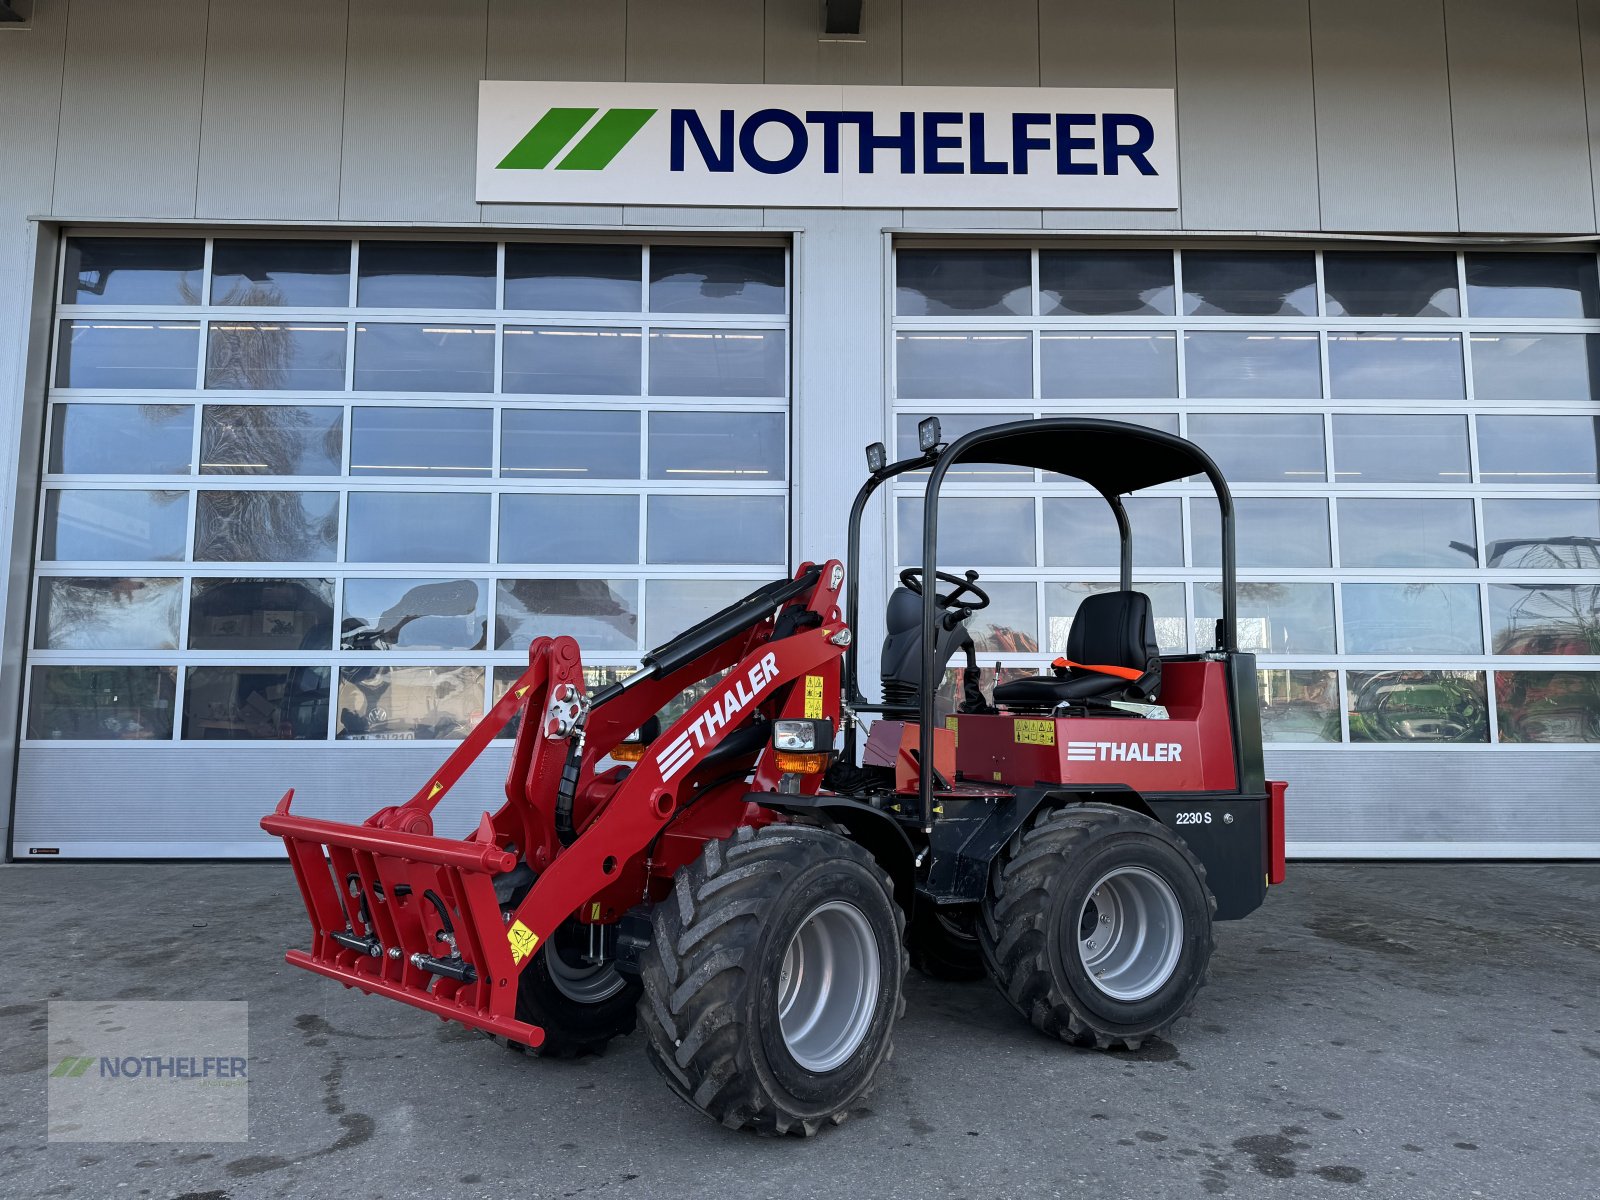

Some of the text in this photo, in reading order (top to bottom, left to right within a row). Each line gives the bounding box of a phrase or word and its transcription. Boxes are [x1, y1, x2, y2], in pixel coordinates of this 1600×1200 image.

[670, 108, 1159, 176] NOTHELFER
[687, 651, 780, 749] THALER
[1096, 741, 1183, 762] THALER
[1175, 811, 1212, 825] 2230 S
